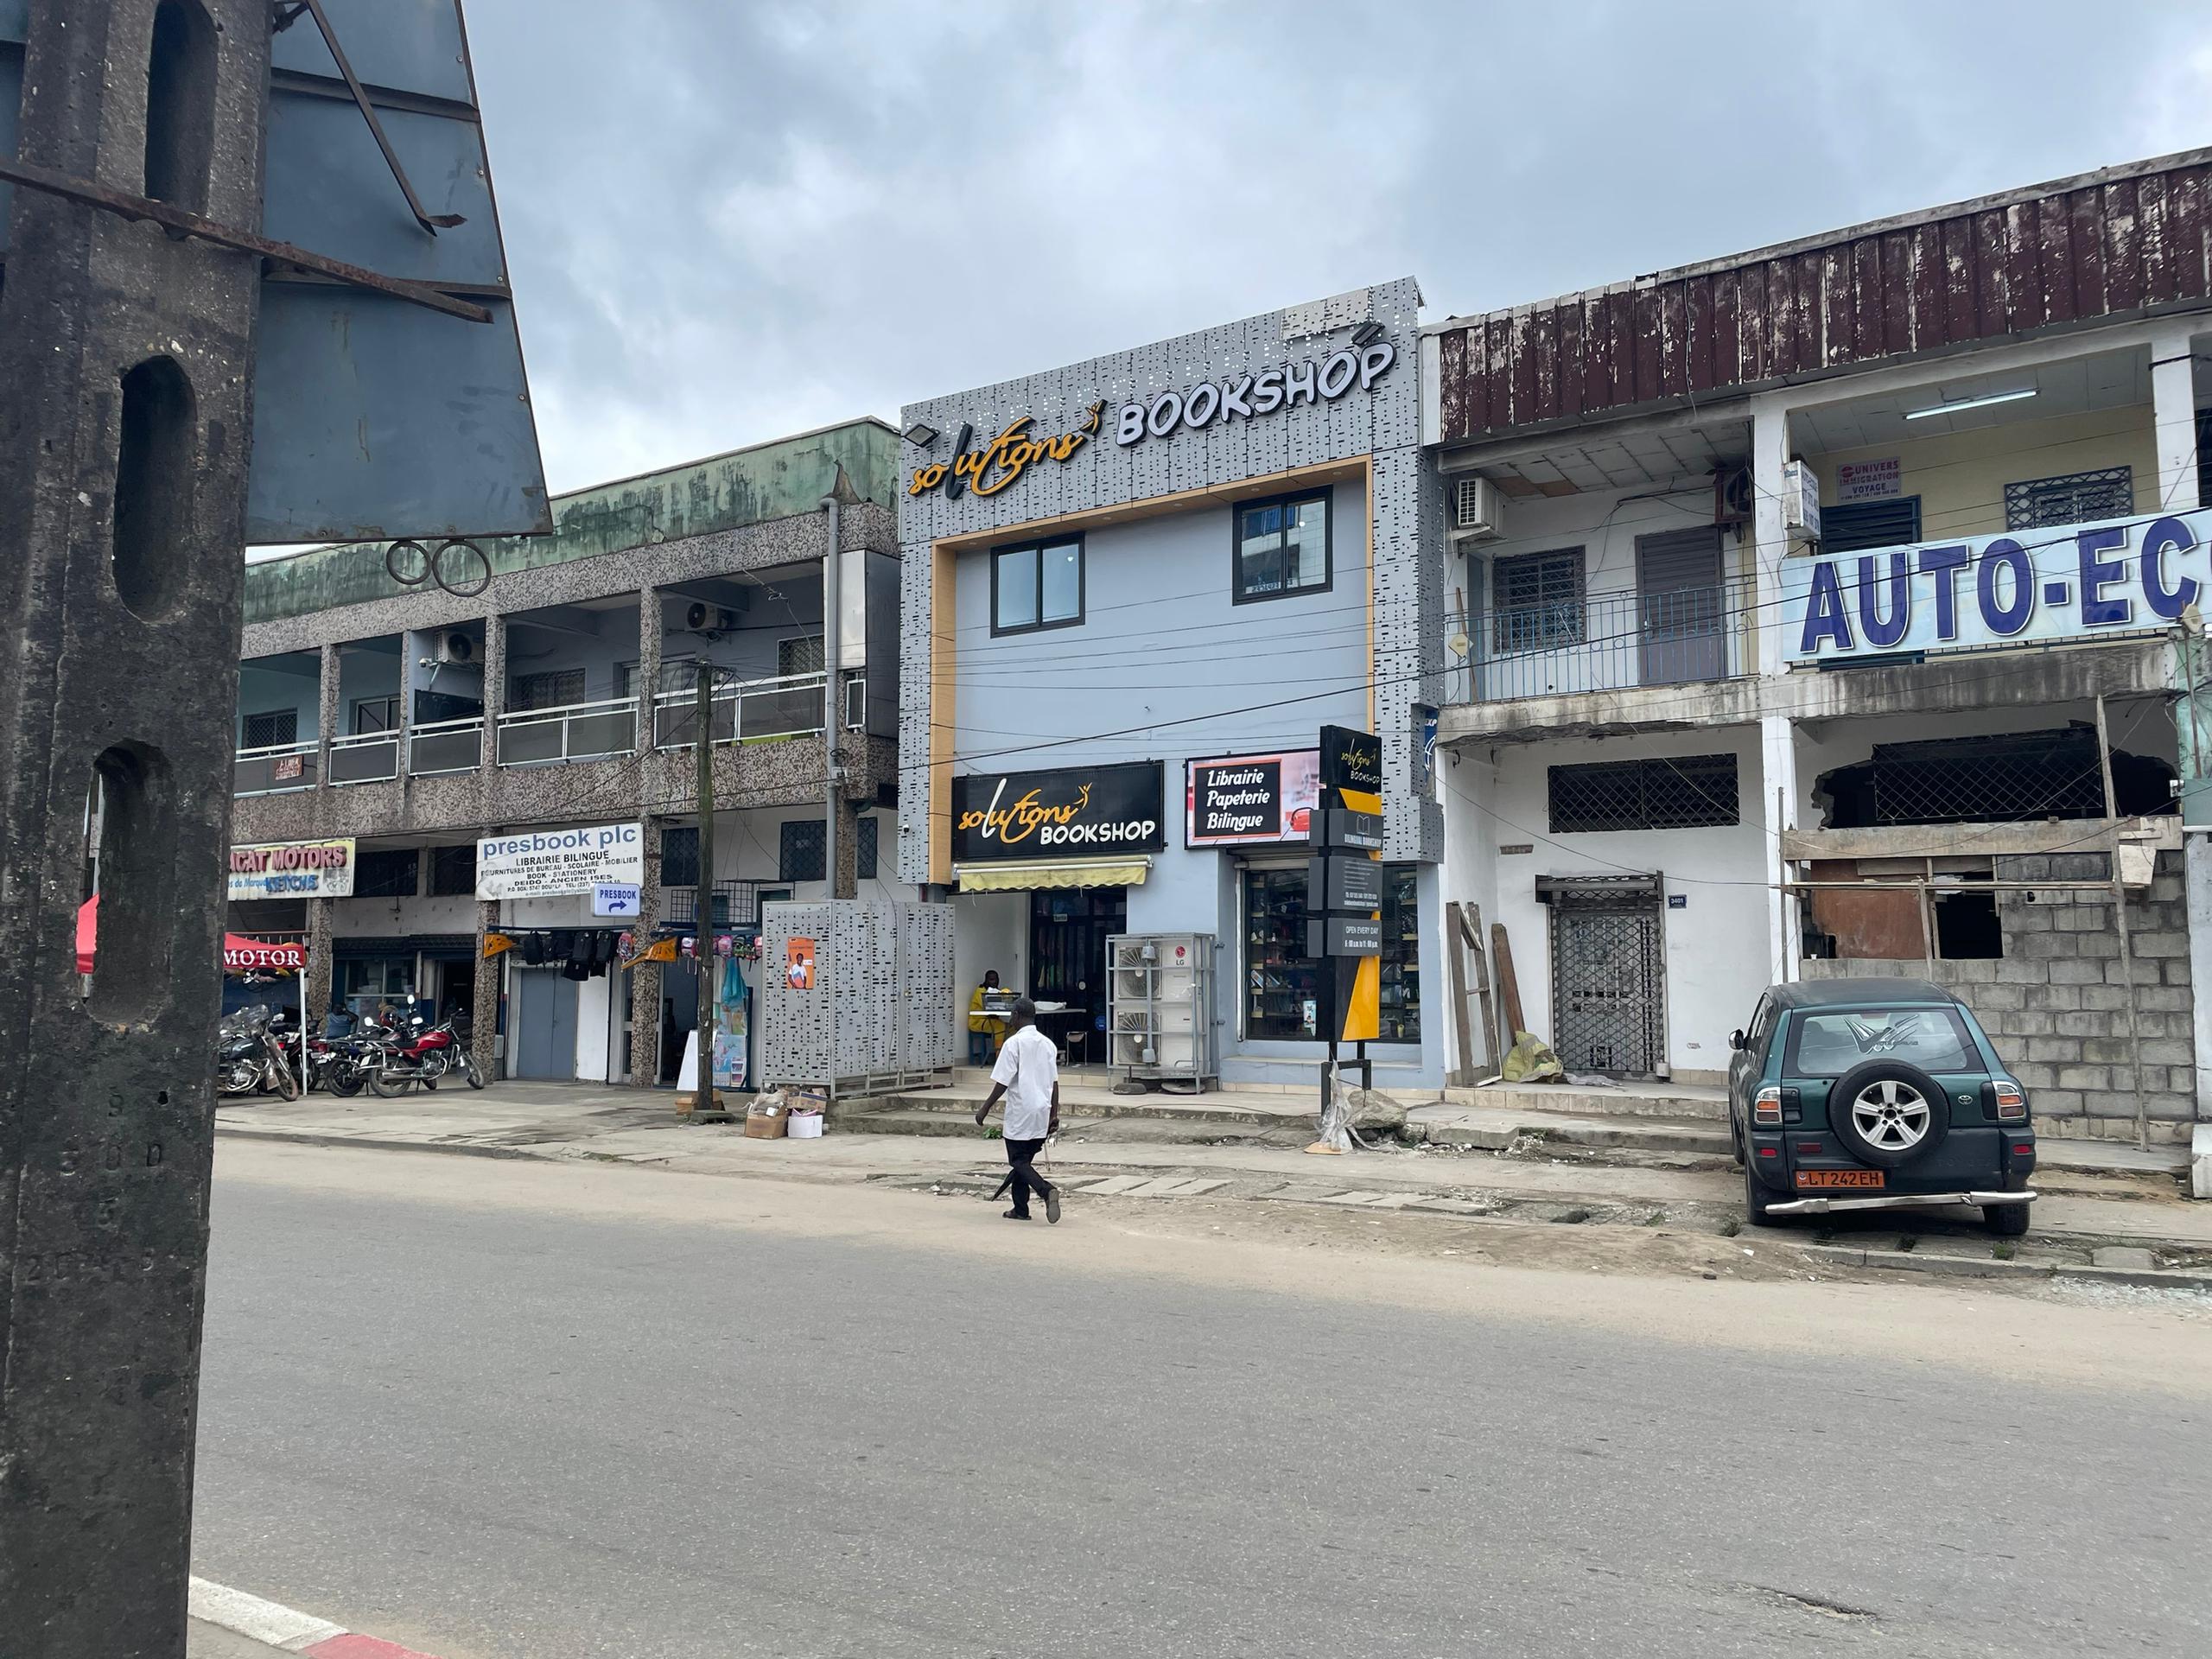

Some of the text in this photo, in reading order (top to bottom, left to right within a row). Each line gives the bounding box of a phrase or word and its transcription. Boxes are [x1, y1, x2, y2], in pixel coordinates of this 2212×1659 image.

[1116, 341, 1397, 448] BOOKSHOP
[1854, 460, 1899, 474] UNIVERS
[1840, 471, 1899, 485] IMMIGRATION
[1852, 482, 1887, 494] VOYAGE
[1799, 516, 2212, 654] AUTO-EC
[1206, 767, 1264, 787] Librairie
[1350, 770, 1381, 785] BOOKSHOP
[1206, 789, 1270, 810] Papeterie
[958, 778, 1079, 844] solutions
[1206, 811, 1263, 832] Bilingue
[1039, 820, 1156, 845] BOOKSHOP
[483, 826, 637, 860] presbook plc
[272, 846, 346, 870] MOTORS
[516, 850, 609, 867] LIBRAIRIE BILINGUE
[568, 861, 600, 869] SCOLAIRE
[605, 856, 638, 865] MOBILIER
[553, 868, 597, 878] STATIONERY
[600, 889, 637, 899] PRESBOOK
[1345, 925, 1357, 934] OPEN
[225, 950, 302, 967] MOTOR
[1808, 1173, 1879, 1186] LT 242 EH
